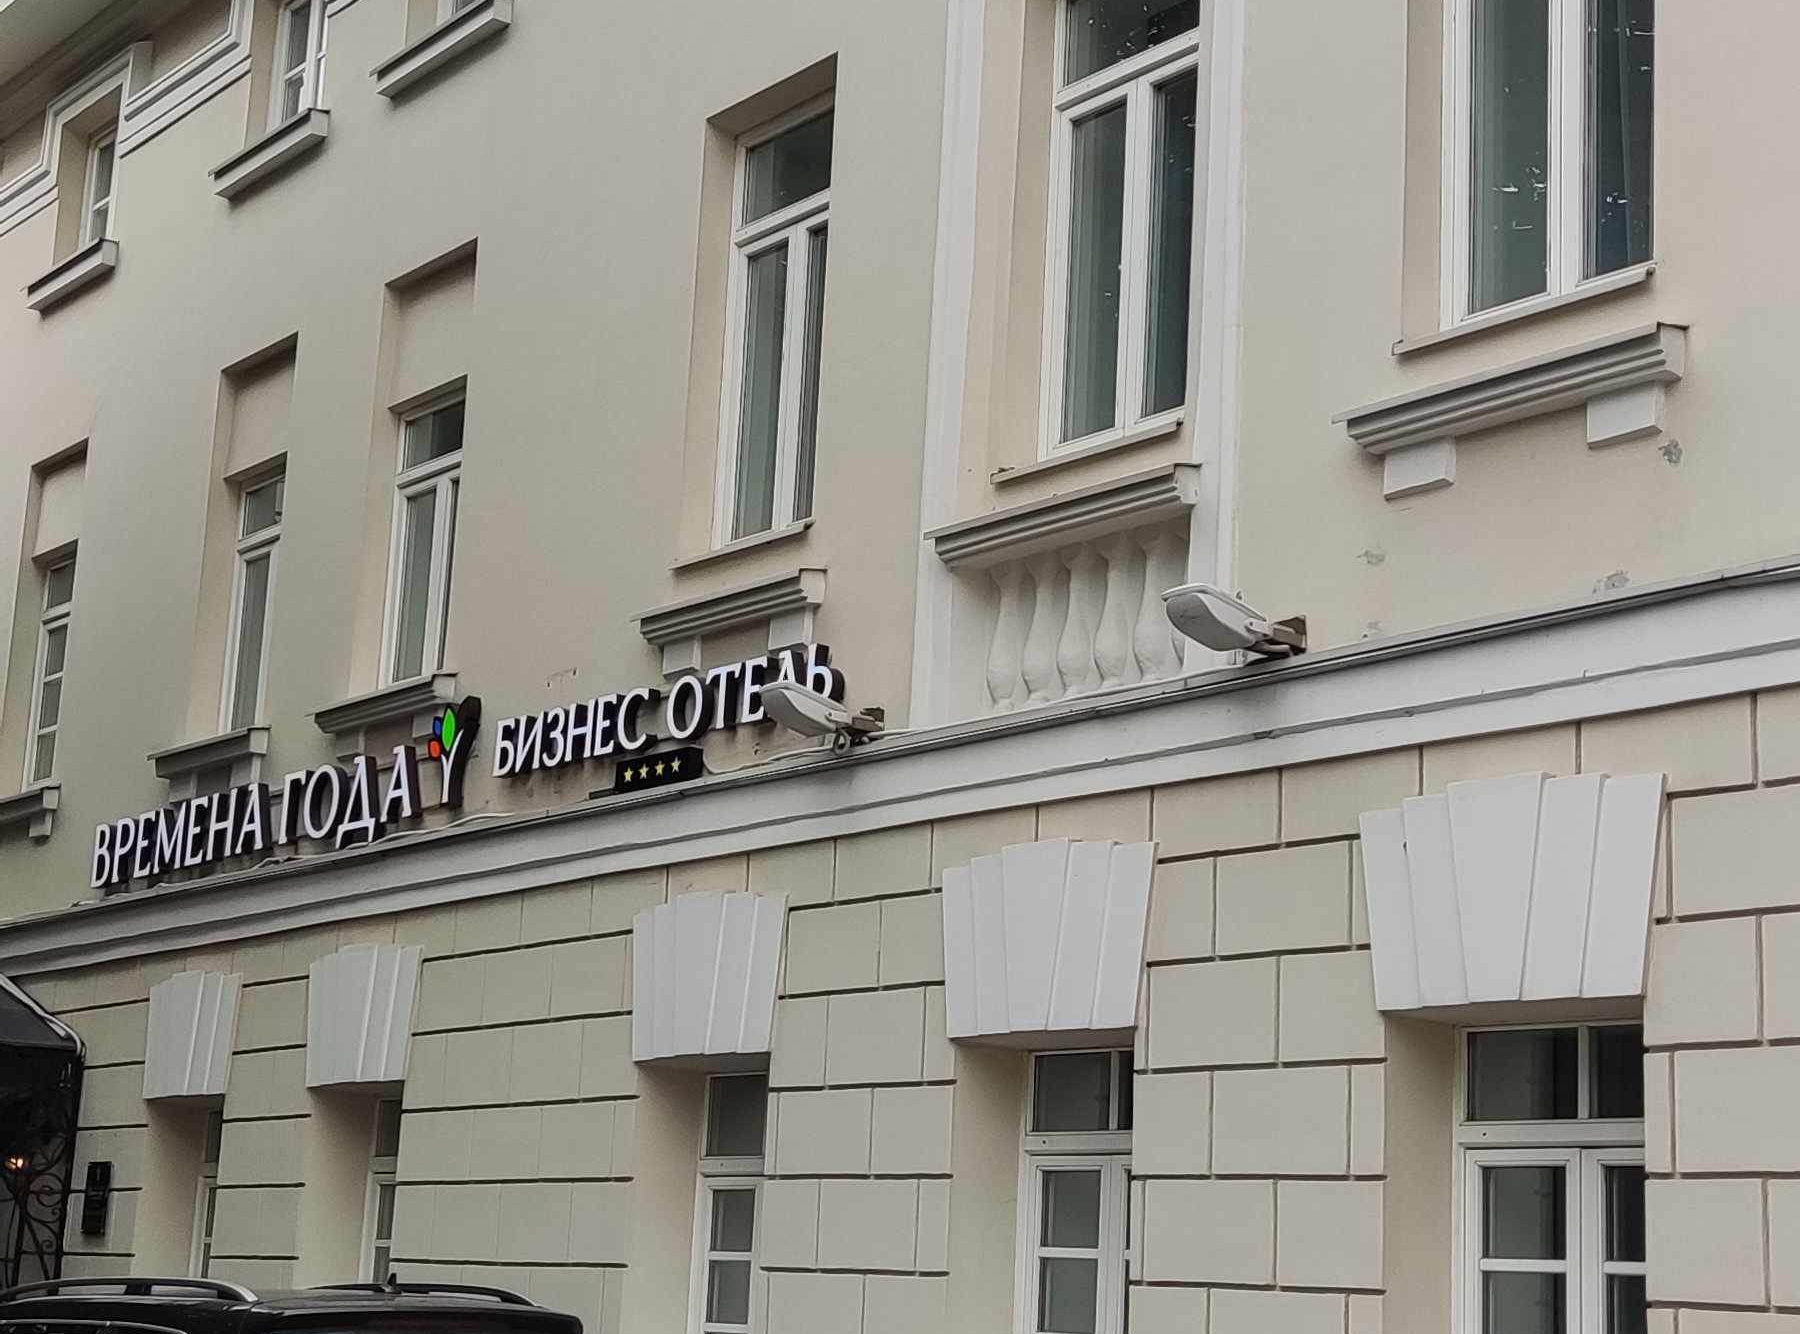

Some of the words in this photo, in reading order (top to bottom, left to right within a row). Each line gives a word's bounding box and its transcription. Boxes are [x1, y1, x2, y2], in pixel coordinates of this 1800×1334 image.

[492, 687, 650, 777] БИЗНЕС
[91, 782, 264, 888] ВРЕМЕНА
[278, 744, 412, 849] ГОДА
